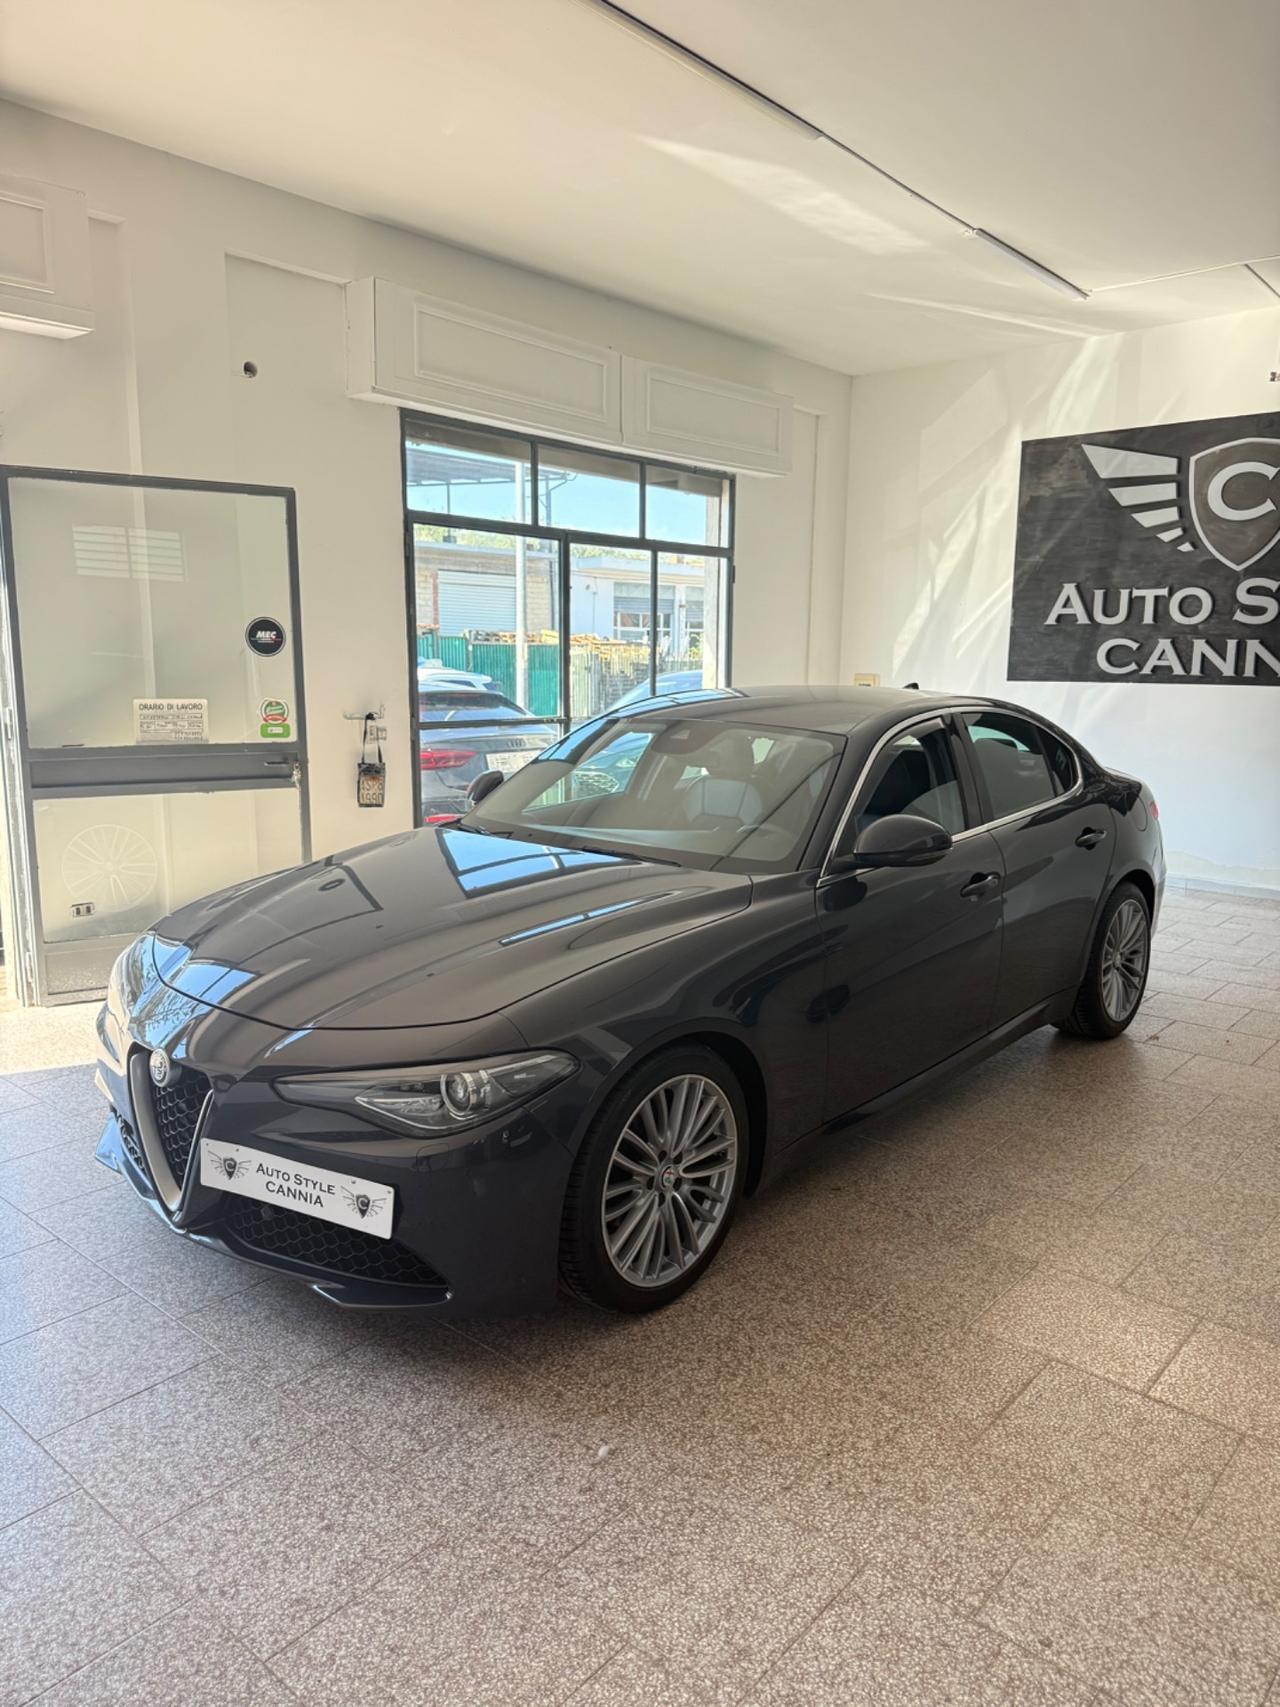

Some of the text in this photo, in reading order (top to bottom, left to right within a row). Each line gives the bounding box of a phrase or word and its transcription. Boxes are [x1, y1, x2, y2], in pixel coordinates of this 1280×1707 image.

[1043, 582, 1213, 626] AUTO
[256, 630, 277, 638] MEC
[138, 703, 203, 711] ORARIO DI LAVORO
[256, 1163, 336, 1196] AUTO STYLE
[265, 1180, 324, 1208] CANNIA
